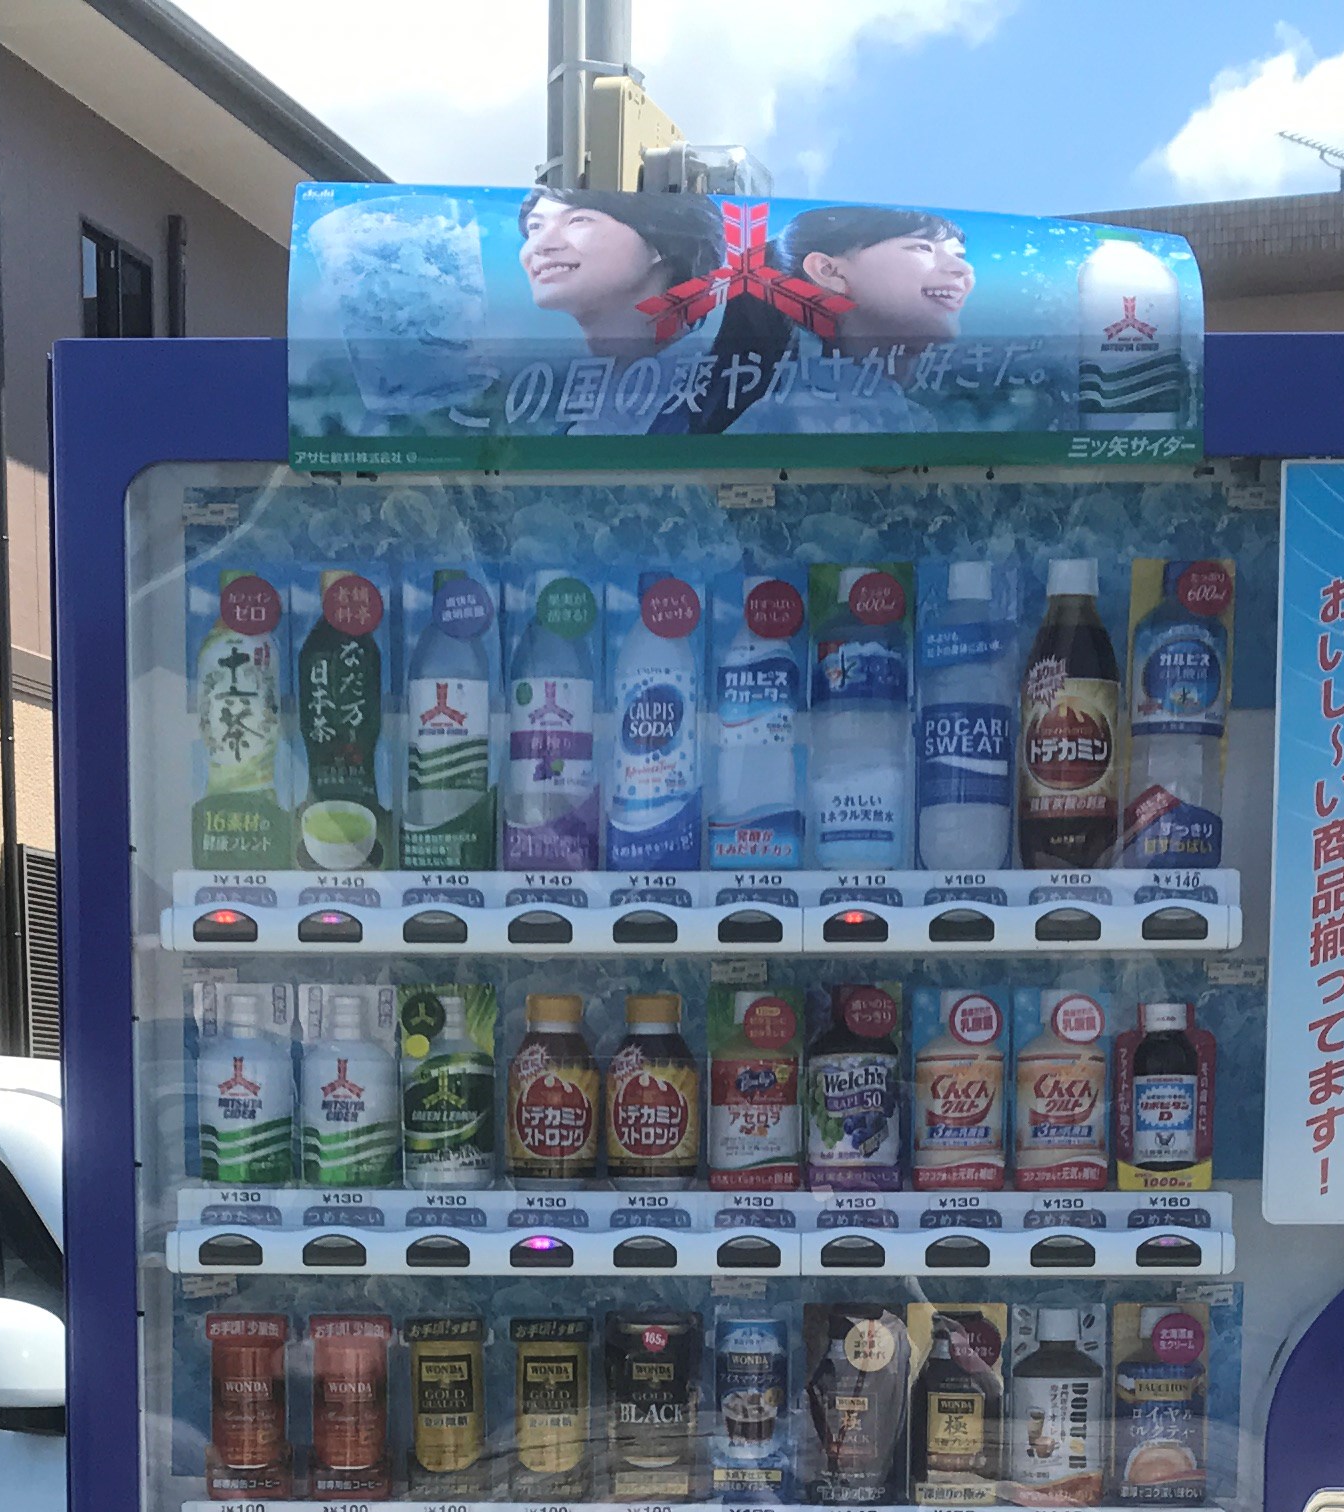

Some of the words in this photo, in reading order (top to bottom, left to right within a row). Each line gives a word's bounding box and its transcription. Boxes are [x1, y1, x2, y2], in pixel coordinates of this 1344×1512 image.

[448, 338, 1048, 428] この国の爽やかさが好きだ。
[1068, 435, 1196, 458] 三ツ矢サイダー
[233, 604, 266, 622] ゼロ
[1159, 652, 1211, 667] カルピス
[725, 671, 788, 687] カルピス
[724, 687, 789, 703] ウォーター
[308, 659, 337, 744] 日本茶
[629, 703, 675, 722] CALPIS
[629, 721, 675, 738] SODA
[925, 717, 1010, 738] POCARI
[925, 735, 1004, 756] SWEAT
[1030, 737, 1109, 763] ドデカミン
[831, 795, 883, 807] うれしい
[1160, 821, 1213, 838] すっきり
[220, 874, 267, 886] ¥140
[317, 876, 366, 888] ¥140
[422, 874, 470, 886] ¥140
[525, 874, 573, 886] ¥140
[629, 875, 677, 887] ¥140
[734, 874, 783, 886] ¥140
[838, 875, 886, 887] ¥110
[824, 1067, 885, 1094] Welch's
[863, 1091, 882, 1108] 50
[729, 1111, 781, 1127] アセロラ
[1157, 1111, 1173, 1122] D
[221, 1192, 261, 1203] ¥130
[323, 1193, 363, 1204] ¥130
[427, 1195, 467, 1206] ¥130
[527, 1197, 567, 1208] ¥130
[629, 1196, 669, 1207] ¥130
[734, 1196, 774, 1207] ¥130
[836, 1197, 876, 1208] ¥130
[939, 1197, 980, 1208] ¥130
[1044, 1198, 1084, 1209] ¥130
[1159, 1339, 1195, 1350] 生クリーム
[730, 1354, 770, 1366] WONDA
[424, 1364, 465, 1377] WONDA
[529, 1365, 570, 1377] WONDA
[224, 1381, 269, 1393] WONDA
[328, 1382, 373, 1394] WONDA
[424, 1388, 465, 1400] GOLD
[529, 1389, 570, 1400] GOLD
[940, 1400, 973, 1412] WONDA
[620, 1403, 683, 1424] BLACK
[1132, 1407, 1192, 1422] ロイヤル
[944, 1414, 968, 1436] 極
